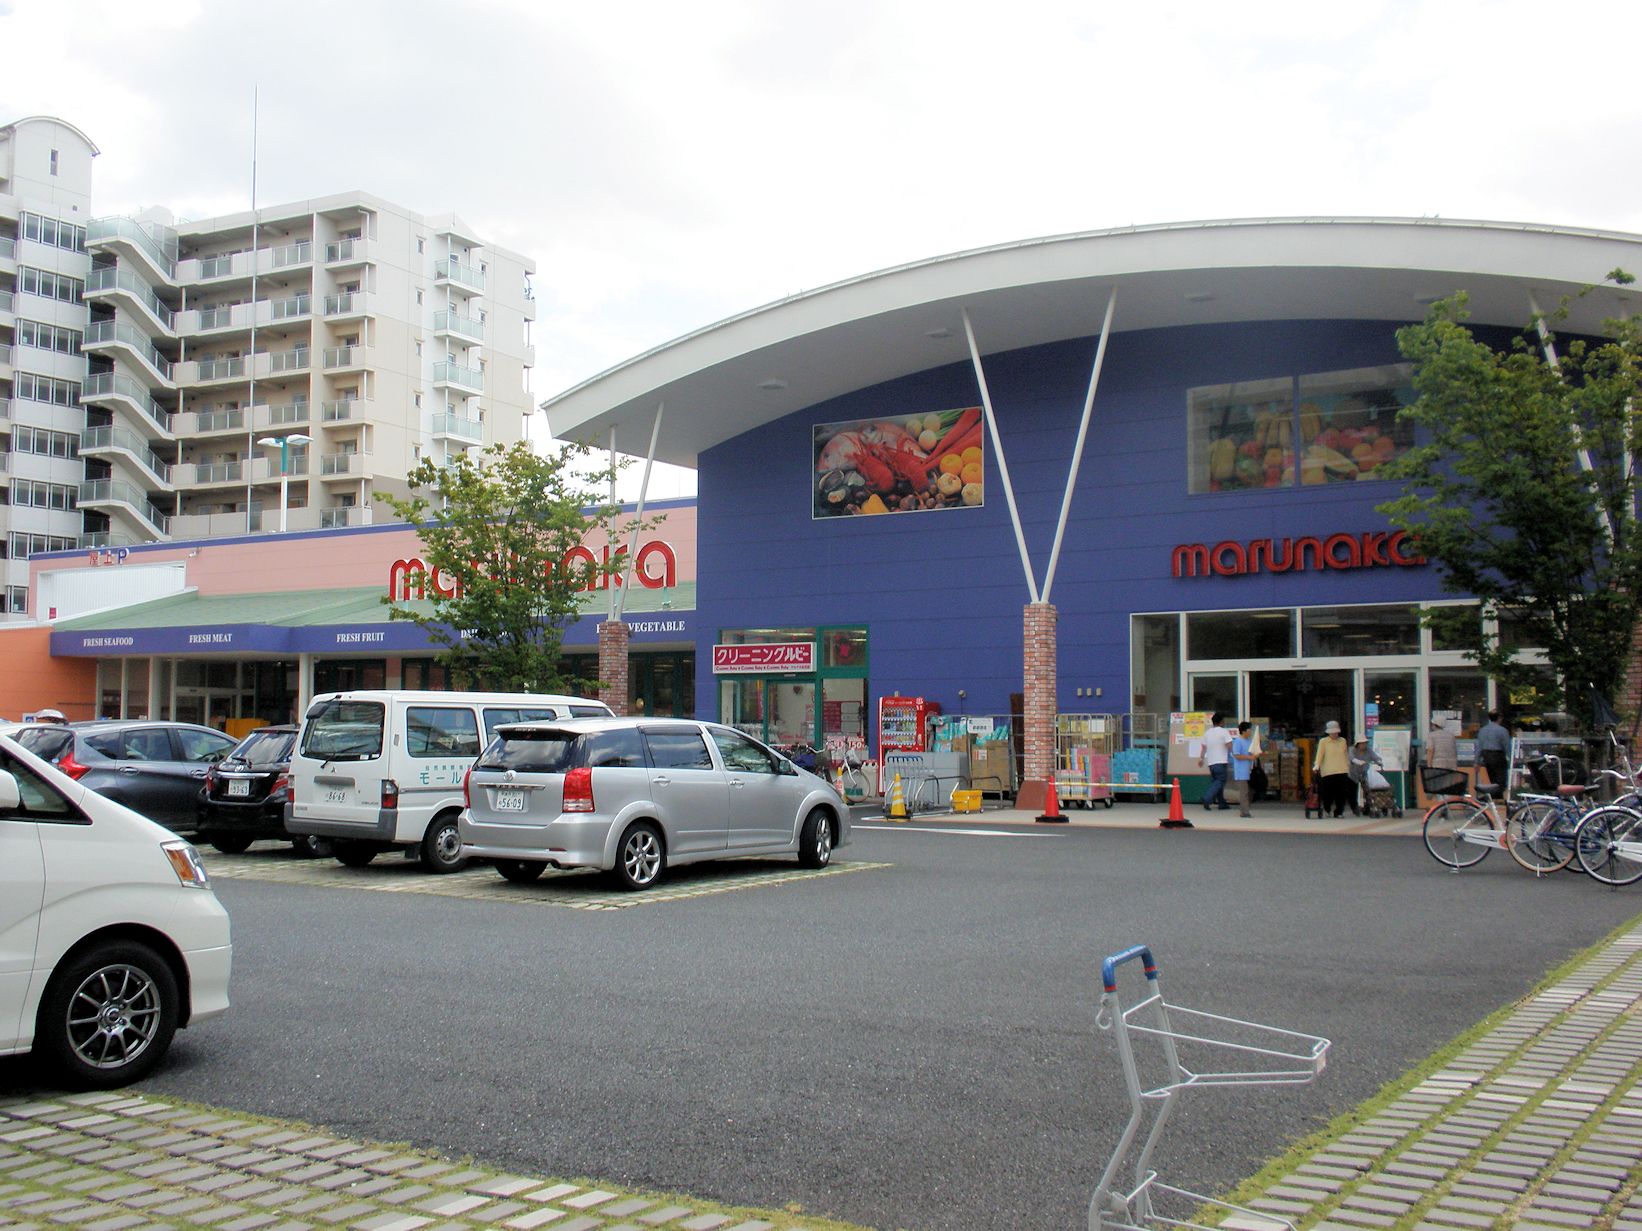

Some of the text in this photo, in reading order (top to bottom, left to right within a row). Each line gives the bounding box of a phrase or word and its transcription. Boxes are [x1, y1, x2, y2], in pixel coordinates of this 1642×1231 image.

[1171, 529, 1427, 577] marunaka
[628, 620, 686, 633] VEGETABLE
[83, 636, 134, 647] FRESH SEAFOOD
[189, 633, 233, 643] FRESH MEAT
[336, 632, 385, 643] FRESH FRUIT
[717, 646, 810, 664] クリーニングルビー
